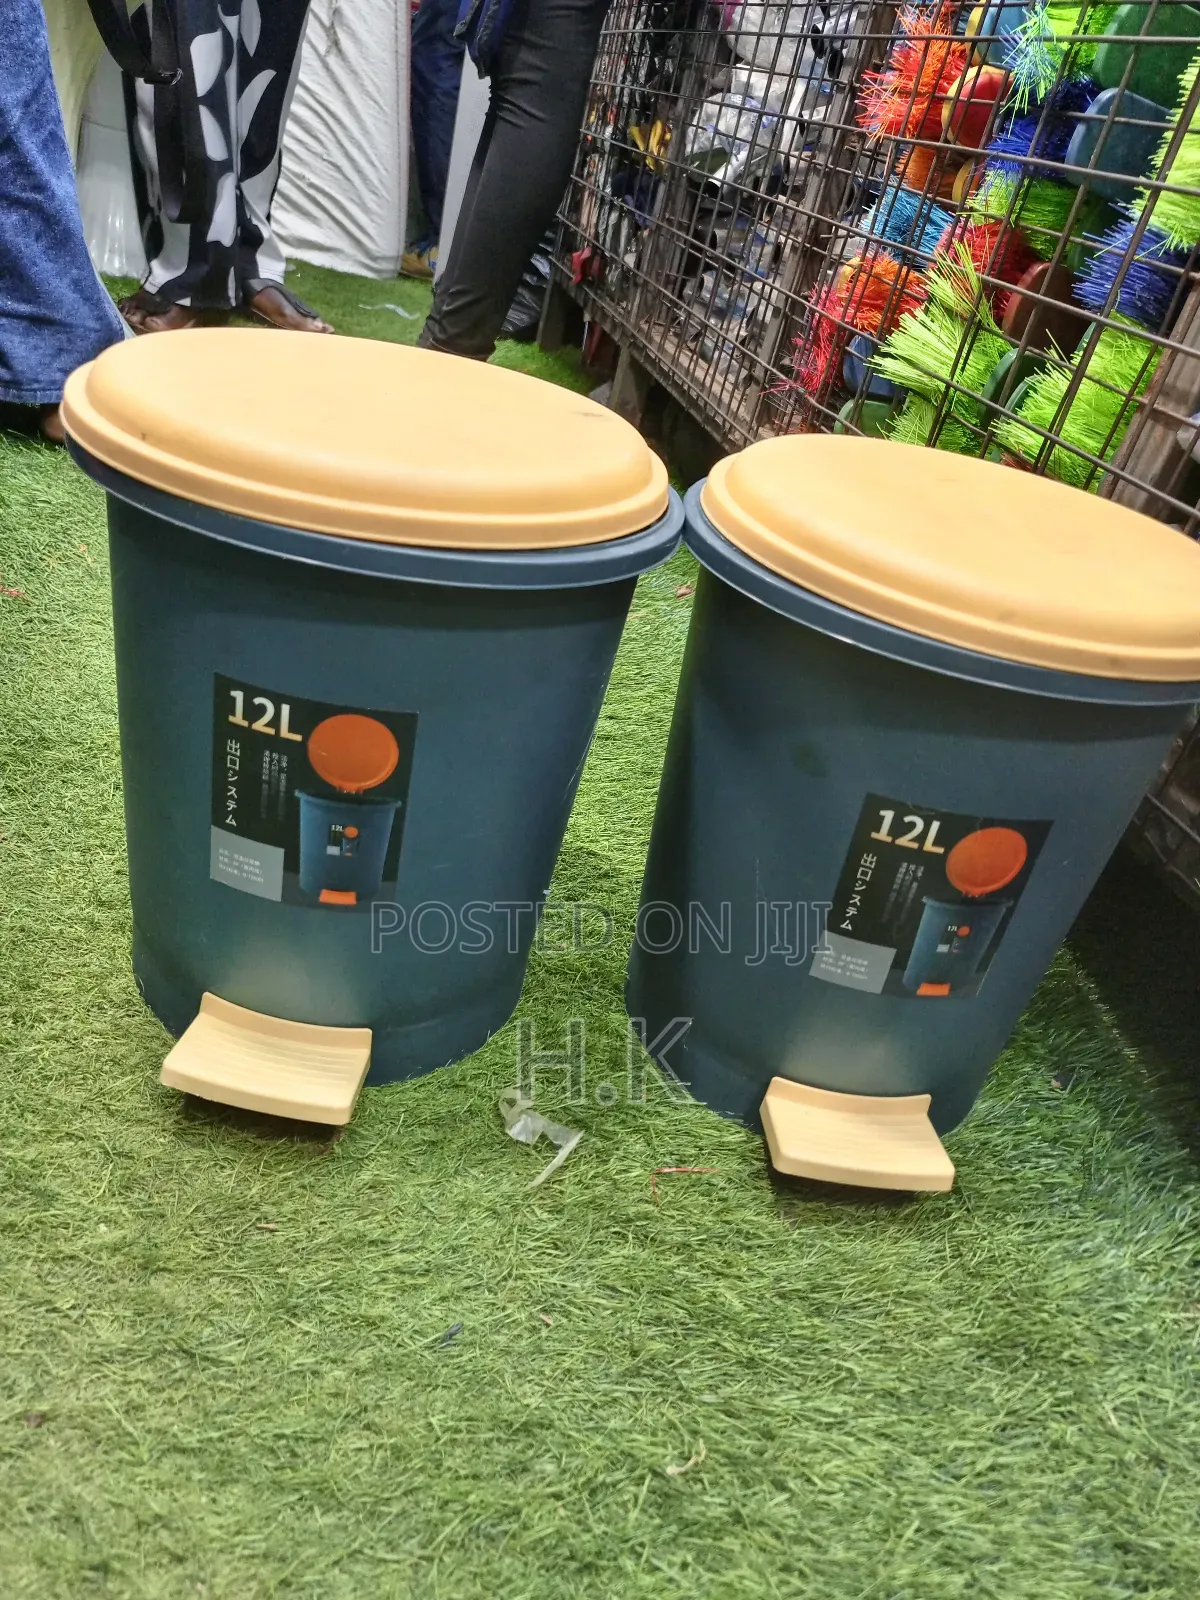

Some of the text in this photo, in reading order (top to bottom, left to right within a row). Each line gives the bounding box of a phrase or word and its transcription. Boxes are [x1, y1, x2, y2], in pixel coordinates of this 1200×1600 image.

[228, 690, 303, 742] 12L
[225, 738, 241, 827] 出口システム
[870, 809, 945, 854] 12L
[840, 852, 877, 931] 出口システム
